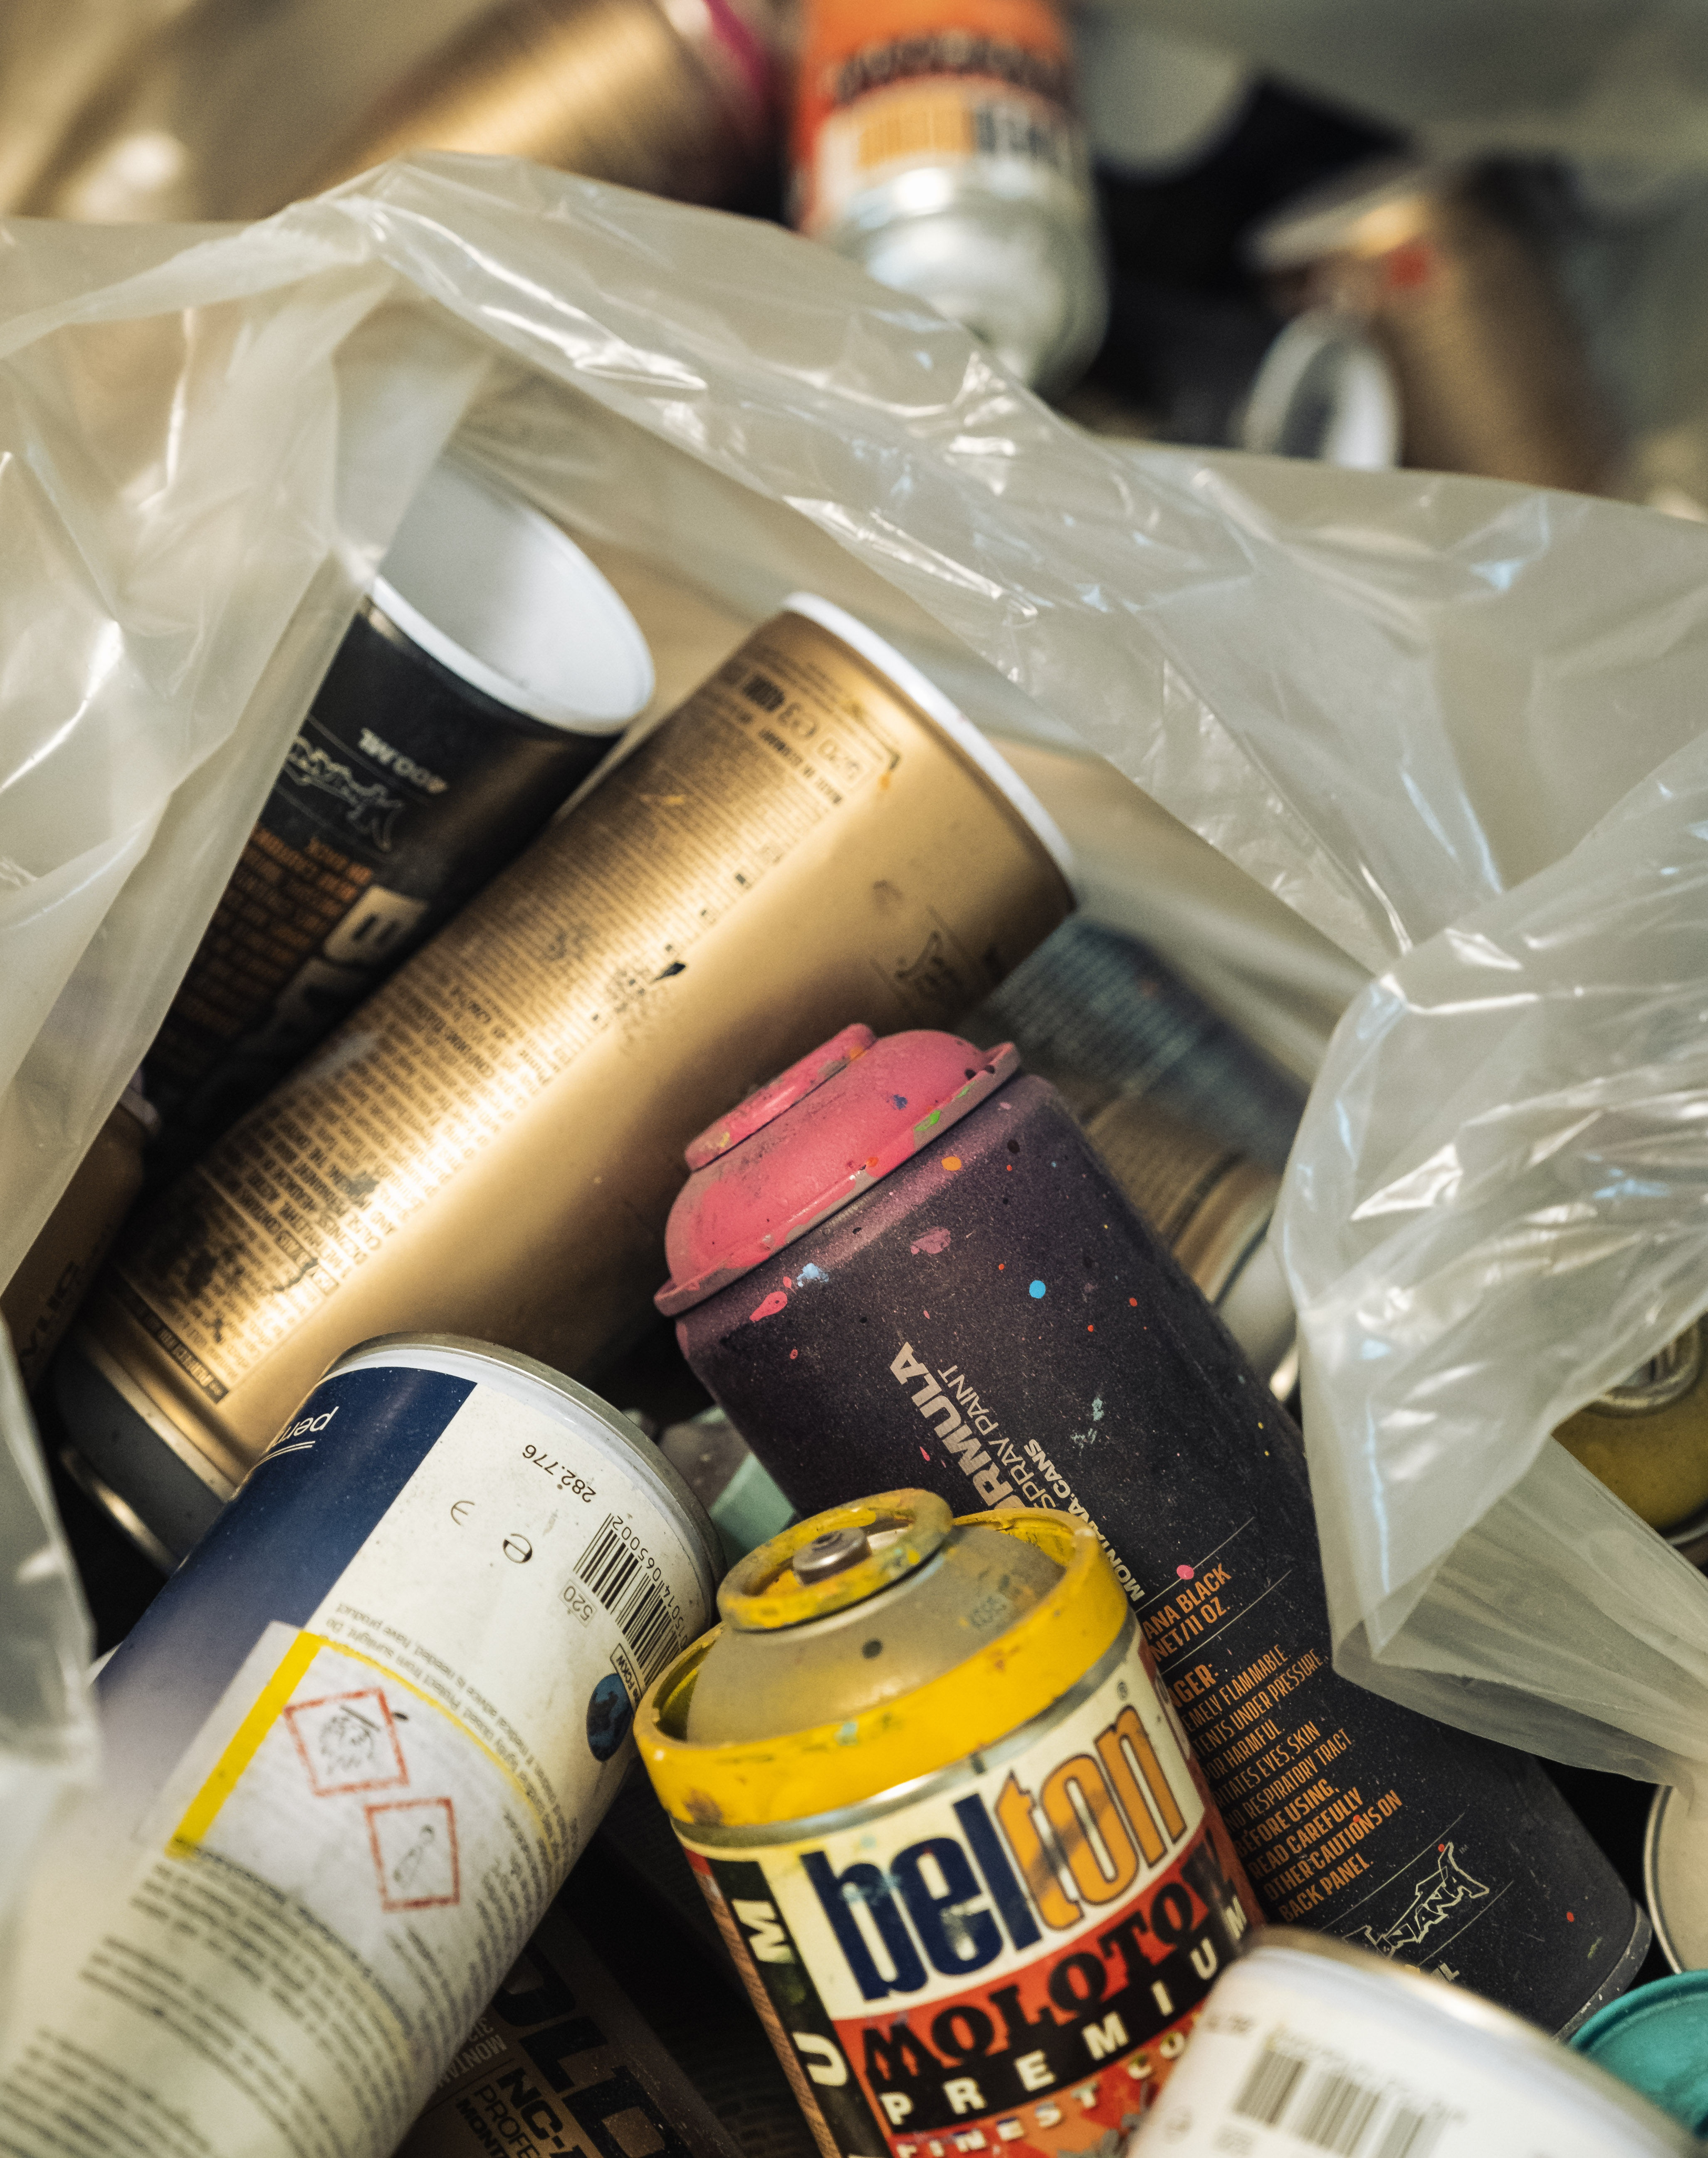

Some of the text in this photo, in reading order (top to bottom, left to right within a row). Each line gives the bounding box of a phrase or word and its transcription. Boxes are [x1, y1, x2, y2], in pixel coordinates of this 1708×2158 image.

[937, 1365, 1056, 1509] SPRAY PAINT
[522, 1444, 596, 1503] 282.776
[563, 1585, 593, 1621] 520
[1176, 1563, 1232, 1613] BLACK
[1200, 1596, 1231, 1623] OZ.
[335, 1604, 384, 1634] product
[384, 1626, 412, 1649] have
[1219, 1644, 1288, 1705] FLAMMABLE
[1229, 1694, 1273, 1730] UNDER
[1267, 1648, 1323, 1702] PRESSURE
[1223, 1719, 1286, 1767] HARMFUL.
[1256, 1744, 1295, 1778] EYES,
[1287, 1720, 1321, 1755] SKIN
[1244, 1757, 1319, 1820] RESPIRATORY
[1313, 1728, 1353, 1767] TRACT
[799, 1704, 1188, 2002] belton
[1233, 1810, 1290, 1858] BEFORE
[1250, 1787, 1364, 1880] READ CAREFULLY
[1263, 1789, 1403, 1901] OTHER CAUTIONS ON
[1278, 1852, 1375, 1923] BACK PANEL.
[879, 1895, 1247, 2126] PREMIUM
